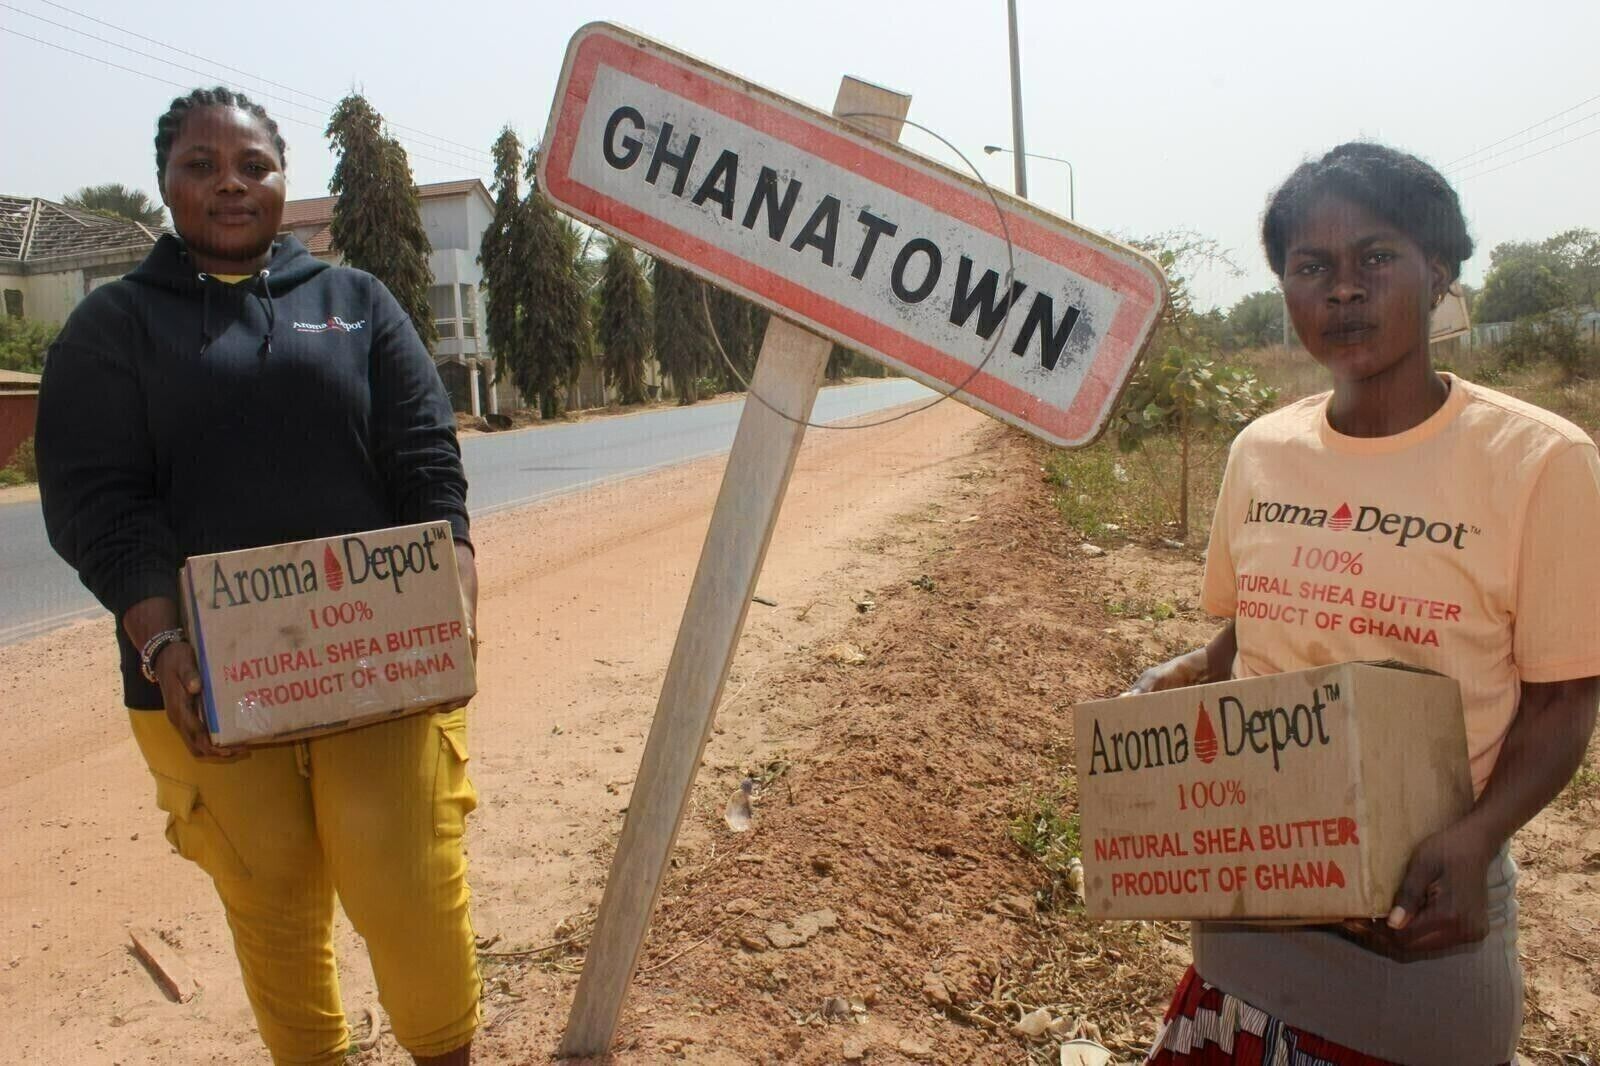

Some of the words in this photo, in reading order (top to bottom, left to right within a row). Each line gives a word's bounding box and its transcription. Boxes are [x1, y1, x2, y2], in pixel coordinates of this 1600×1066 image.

[602, 105, 1081, 371] GHANATOWN
[1244, 498, 1328, 528] Aroma
[1291, 546, 1364, 576] 100%
[210, 559, 319, 610] Aroma
[1235, 574, 1293, 597] TURAL
[1299, 581, 1355, 606] SHEA
[1361, 590, 1462, 623] BUTTER
[309, 600, 374, 630] 100%
[1315, 611, 1343, 632] OF
[1348, 616, 1440, 648] GHANA
[223, 648, 322, 684] NATURAL
[327, 638, 383, 664] SHEA
[386, 620, 463, 653] BUTTER
[244, 674, 346, 710] PRODUCT
[351, 668, 378, 689] OF
[384, 652, 456, 683] GHANA
[1088, 718, 1189, 776] Aroma
[1177, 779, 1246, 811] 100%
[1094, 832, 1189, 862] NATURAL
[1192, 827, 1255, 856] SHEA
[1258, 816, 1361, 851] BUTTER
[1111, 868, 1211, 897] PRODUCT
[1218, 866, 1248, 893] OF
[1254, 860, 1346, 892] GHANA
